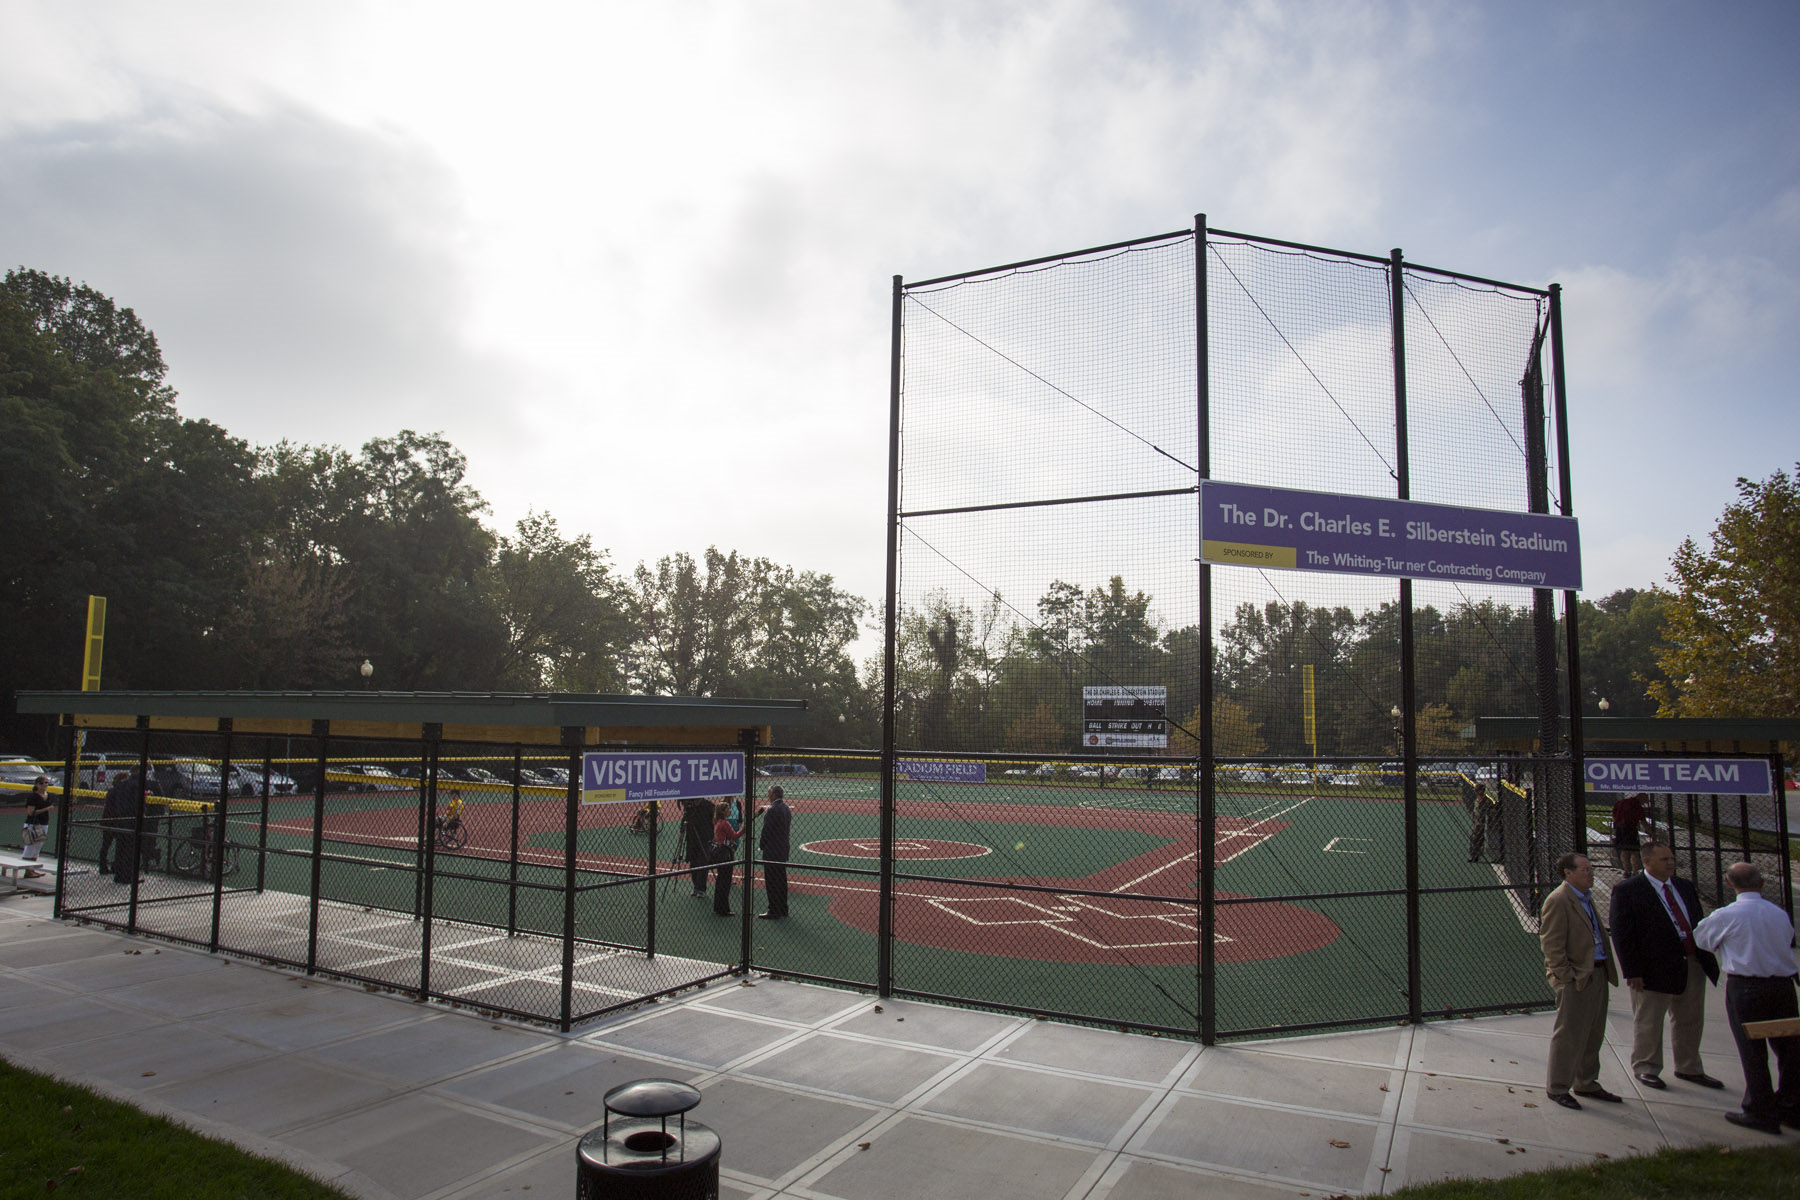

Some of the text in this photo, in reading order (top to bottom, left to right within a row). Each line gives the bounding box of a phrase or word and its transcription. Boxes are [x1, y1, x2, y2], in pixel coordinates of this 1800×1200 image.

[1220, 503, 1568, 552] The Dr. Charles E. Silberstein Stadium
[1223, 548, 1274, 560] SPONSORED BY
[1306, 550, 1330, 565] The
[1427, 560, 1493, 580] Contracting
[1495, 565, 1547, 584] Company
[591, 758, 738, 785] VISITING TEAM
[1584, 762, 1740, 782] OME TEAM
[628, 788, 681, 799] Fancy Hill Foundation
